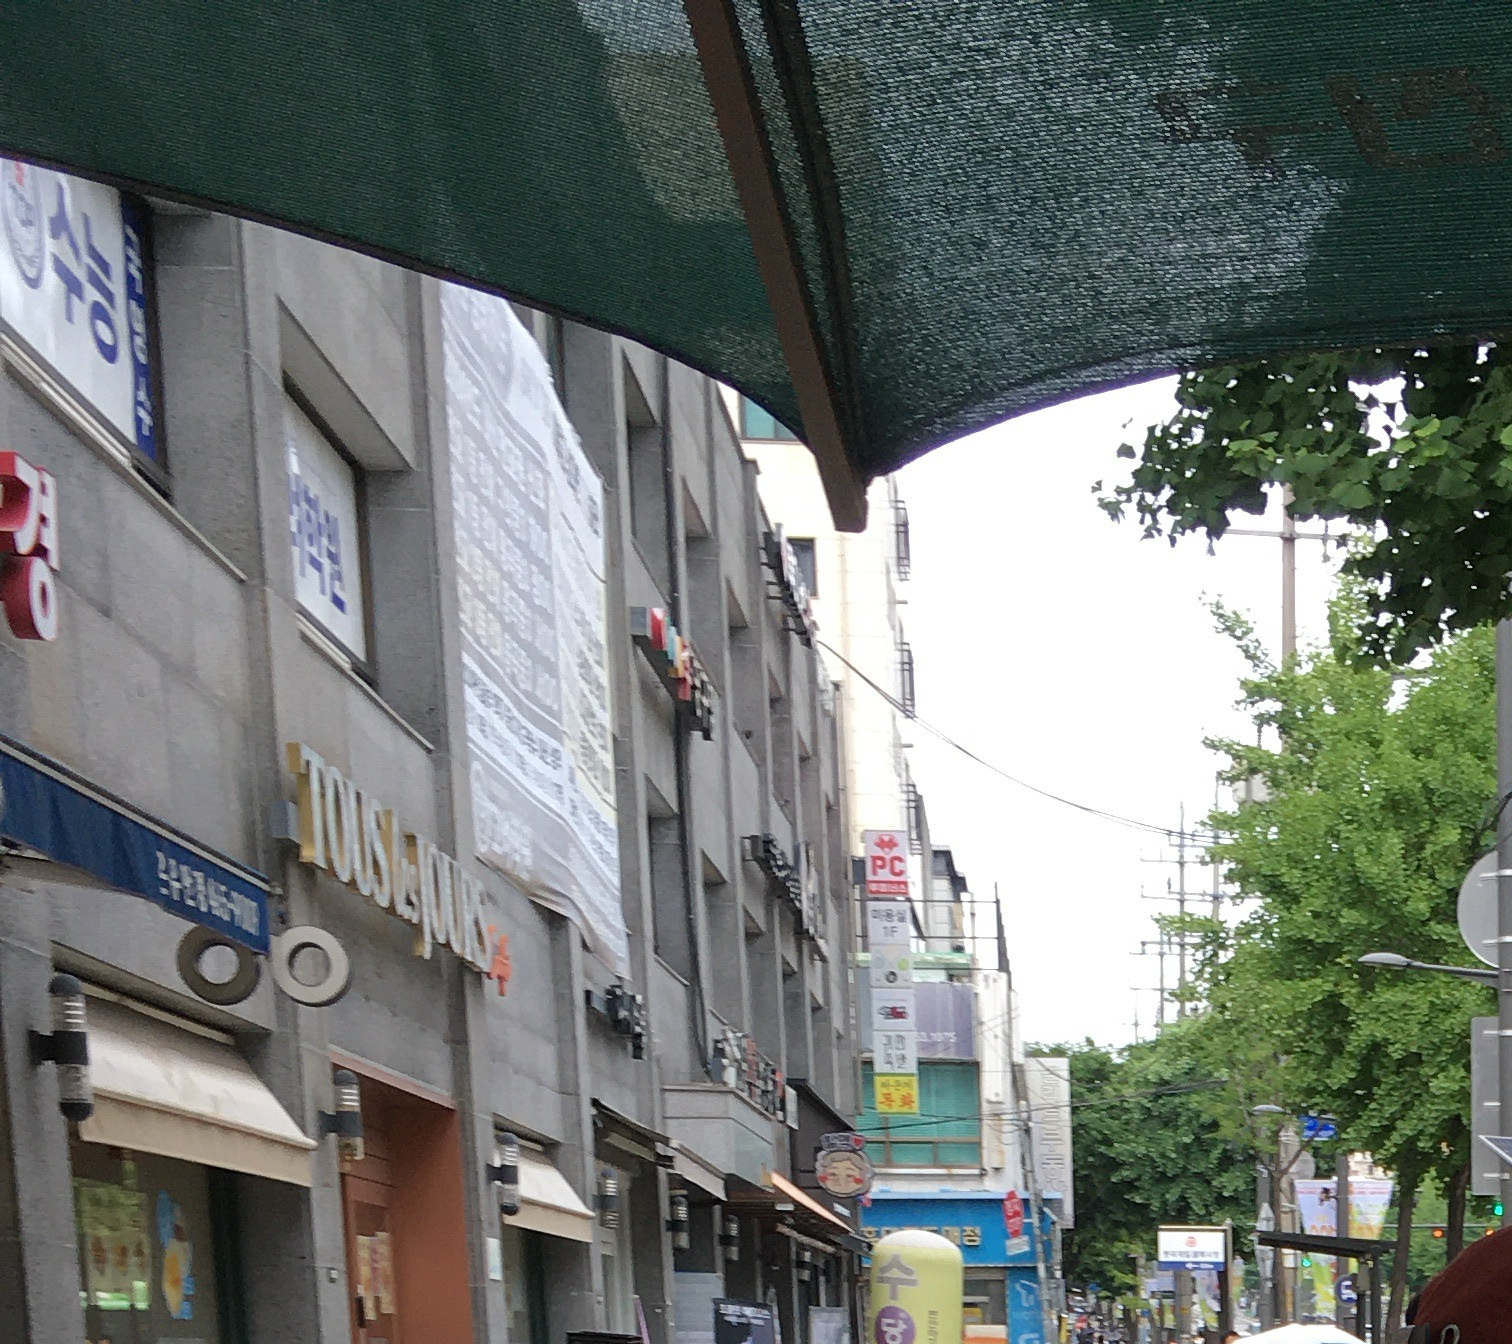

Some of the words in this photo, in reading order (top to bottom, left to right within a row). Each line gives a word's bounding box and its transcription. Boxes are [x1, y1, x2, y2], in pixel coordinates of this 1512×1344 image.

[298, 742, 392, 908] TOUS
[414, 832, 492, 973] JOURS
[869, 855, 905, 877] PC
